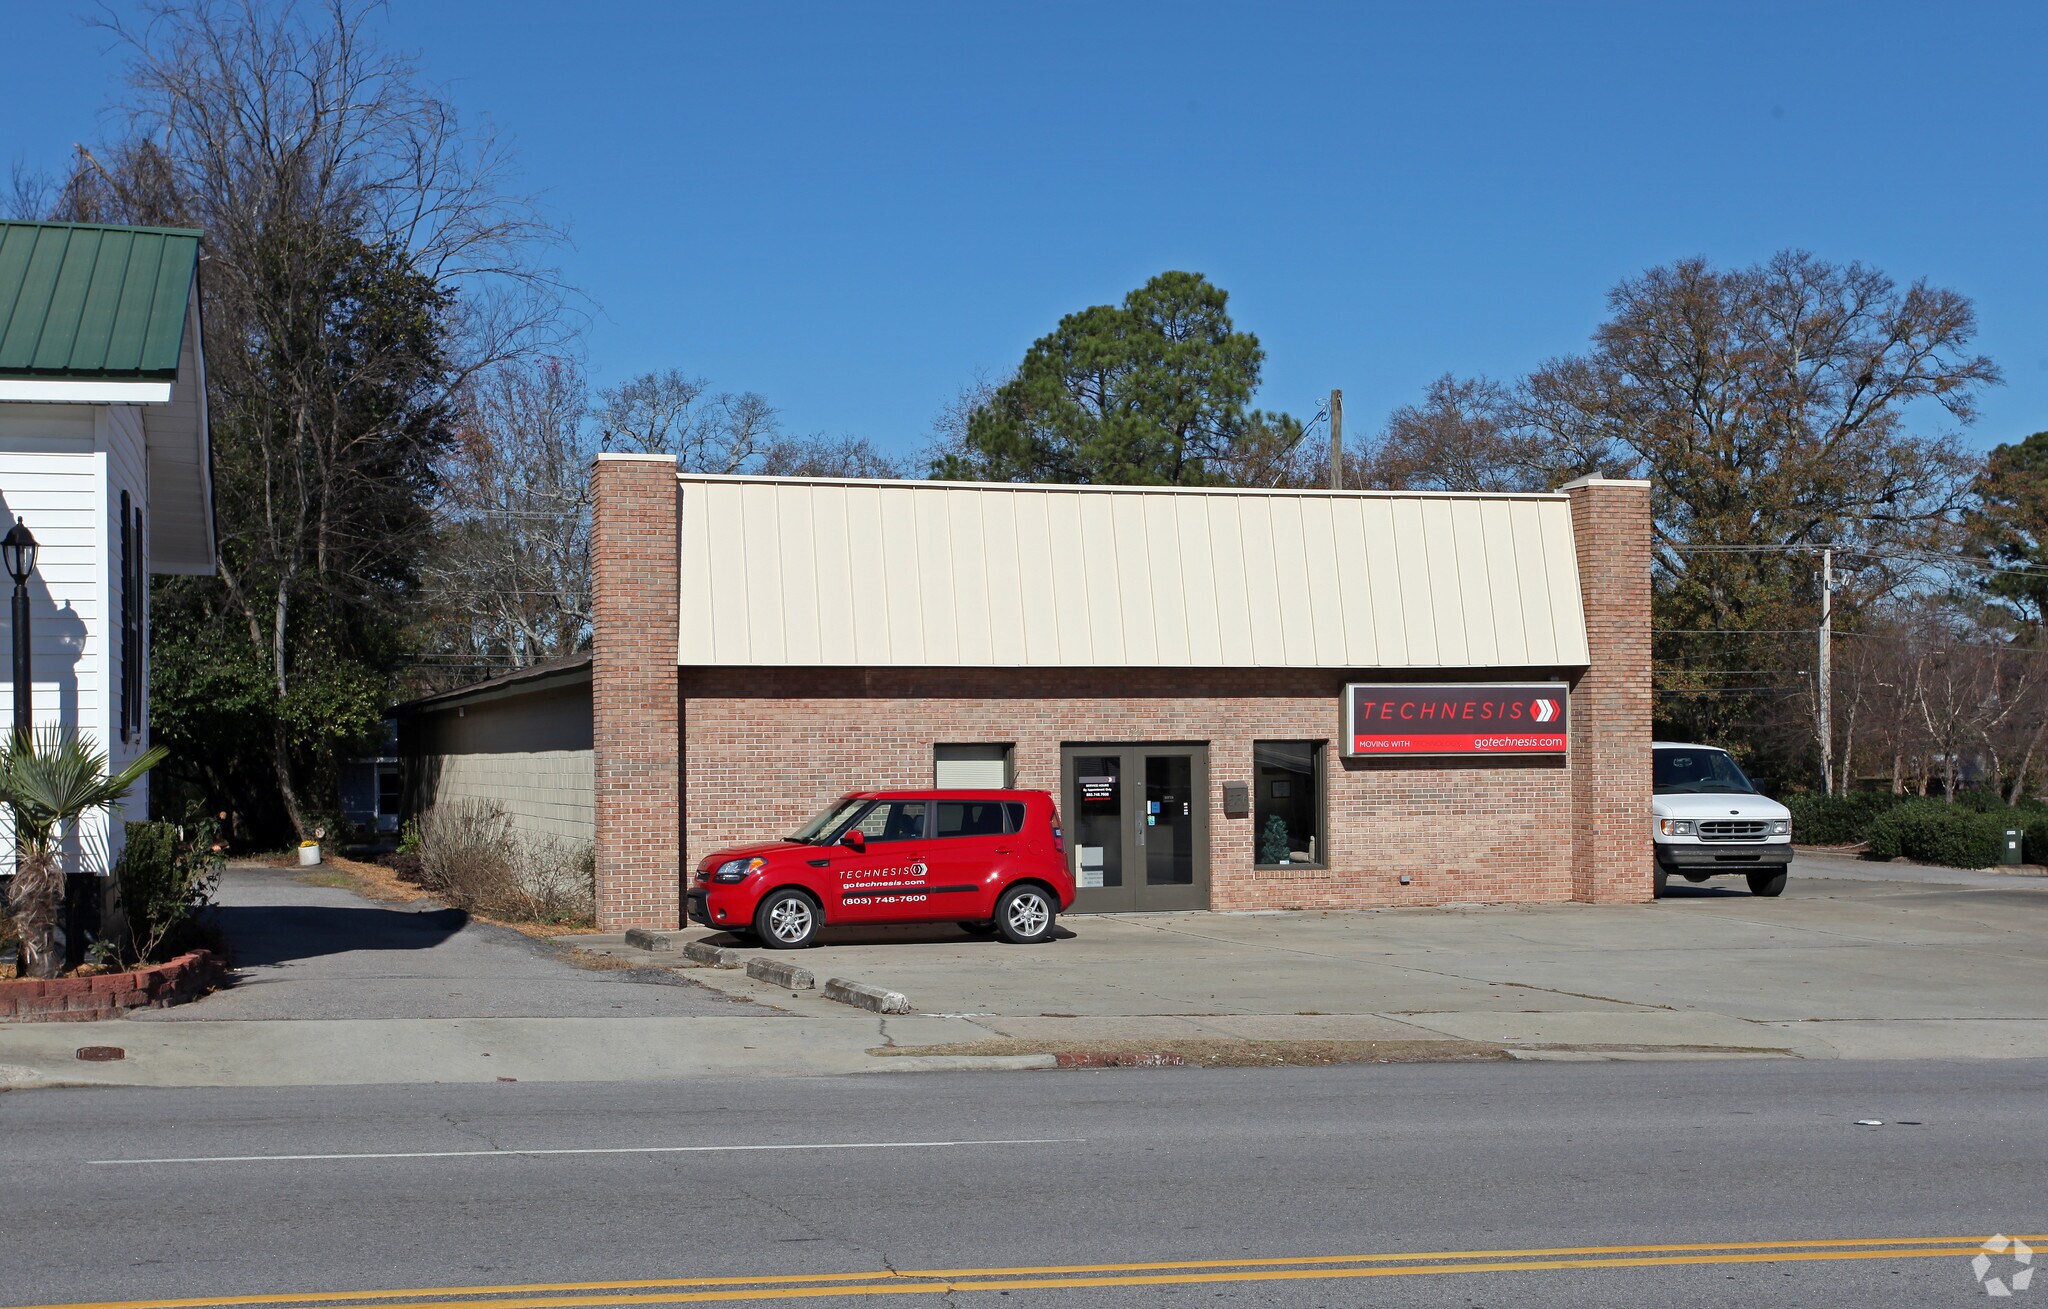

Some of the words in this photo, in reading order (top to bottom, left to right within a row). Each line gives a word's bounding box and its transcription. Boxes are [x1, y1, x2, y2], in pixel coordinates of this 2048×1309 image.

[1363, 702, 1523, 720] TECHNESIS
[1474, 736, 1562, 749] gotechnesis.com
[840, 867, 908, 879] TECHNESIS
[843, 880, 925, 889] gotechnesis.com
[842, 898, 872, 906] (803)
[875, 895, 926, 903] 748-7600
